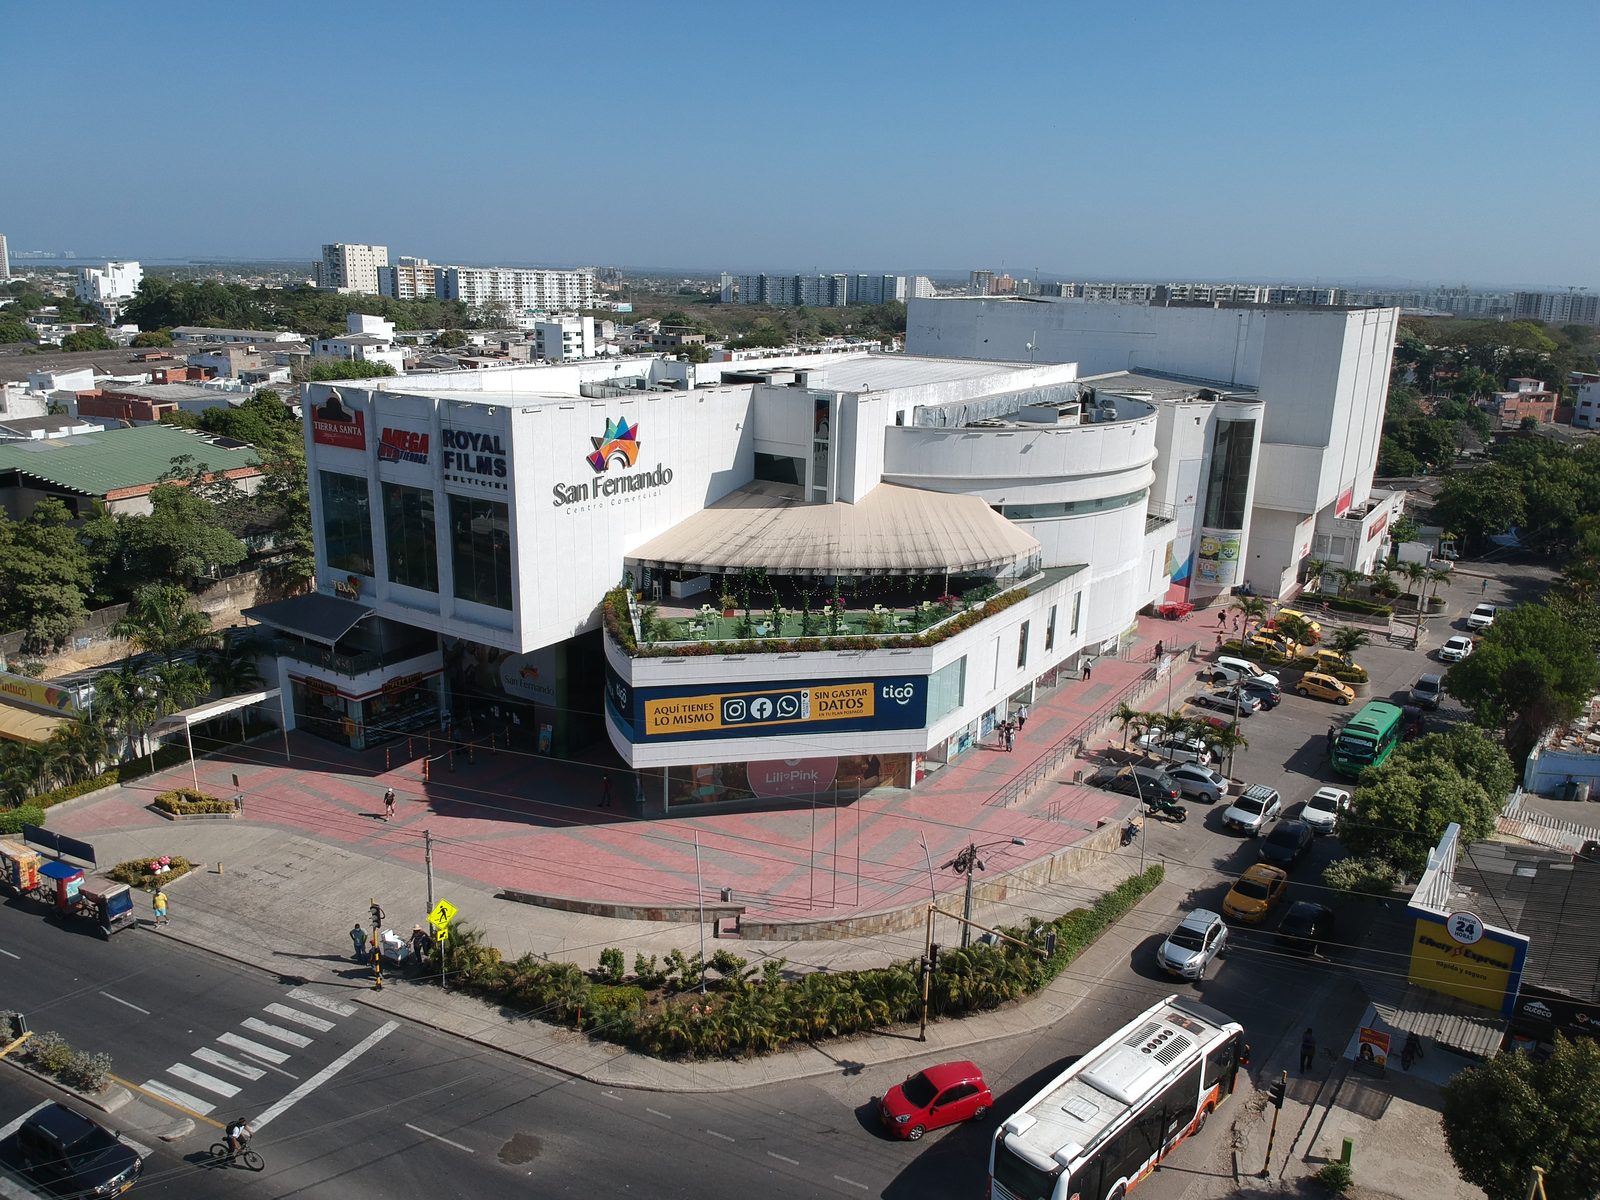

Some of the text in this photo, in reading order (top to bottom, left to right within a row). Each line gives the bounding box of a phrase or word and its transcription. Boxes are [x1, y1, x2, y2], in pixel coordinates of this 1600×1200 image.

[313, 421, 338, 433] TIERRA
[339, 424, 362, 436] SANTA
[380, 427, 429, 458] MEGA
[443, 429, 506, 456] ROYAL
[443, 450, 507, 478] FILMS
[552, 462, 673, 507] San Fernando
[566, 488, 662, 515] Centro Comercial
[504, 674, 555, 697] San Fernando
[814, 688, 868, 700] SIN GASTAR
[882, 682, 914, 705] tigo
[653, 701, 715, 715] AQUÍ TIENES
[819, 697, 864, 712] DATOS
[654, 712, 715, 726] LO MISMO
[765, 769, 818, 784] Lili Pink
[1455, 920, 1475, 935] 24
[1454, 931, 1473, 941] HORAS
[1522, 1004, 1552, 1018] auteco
